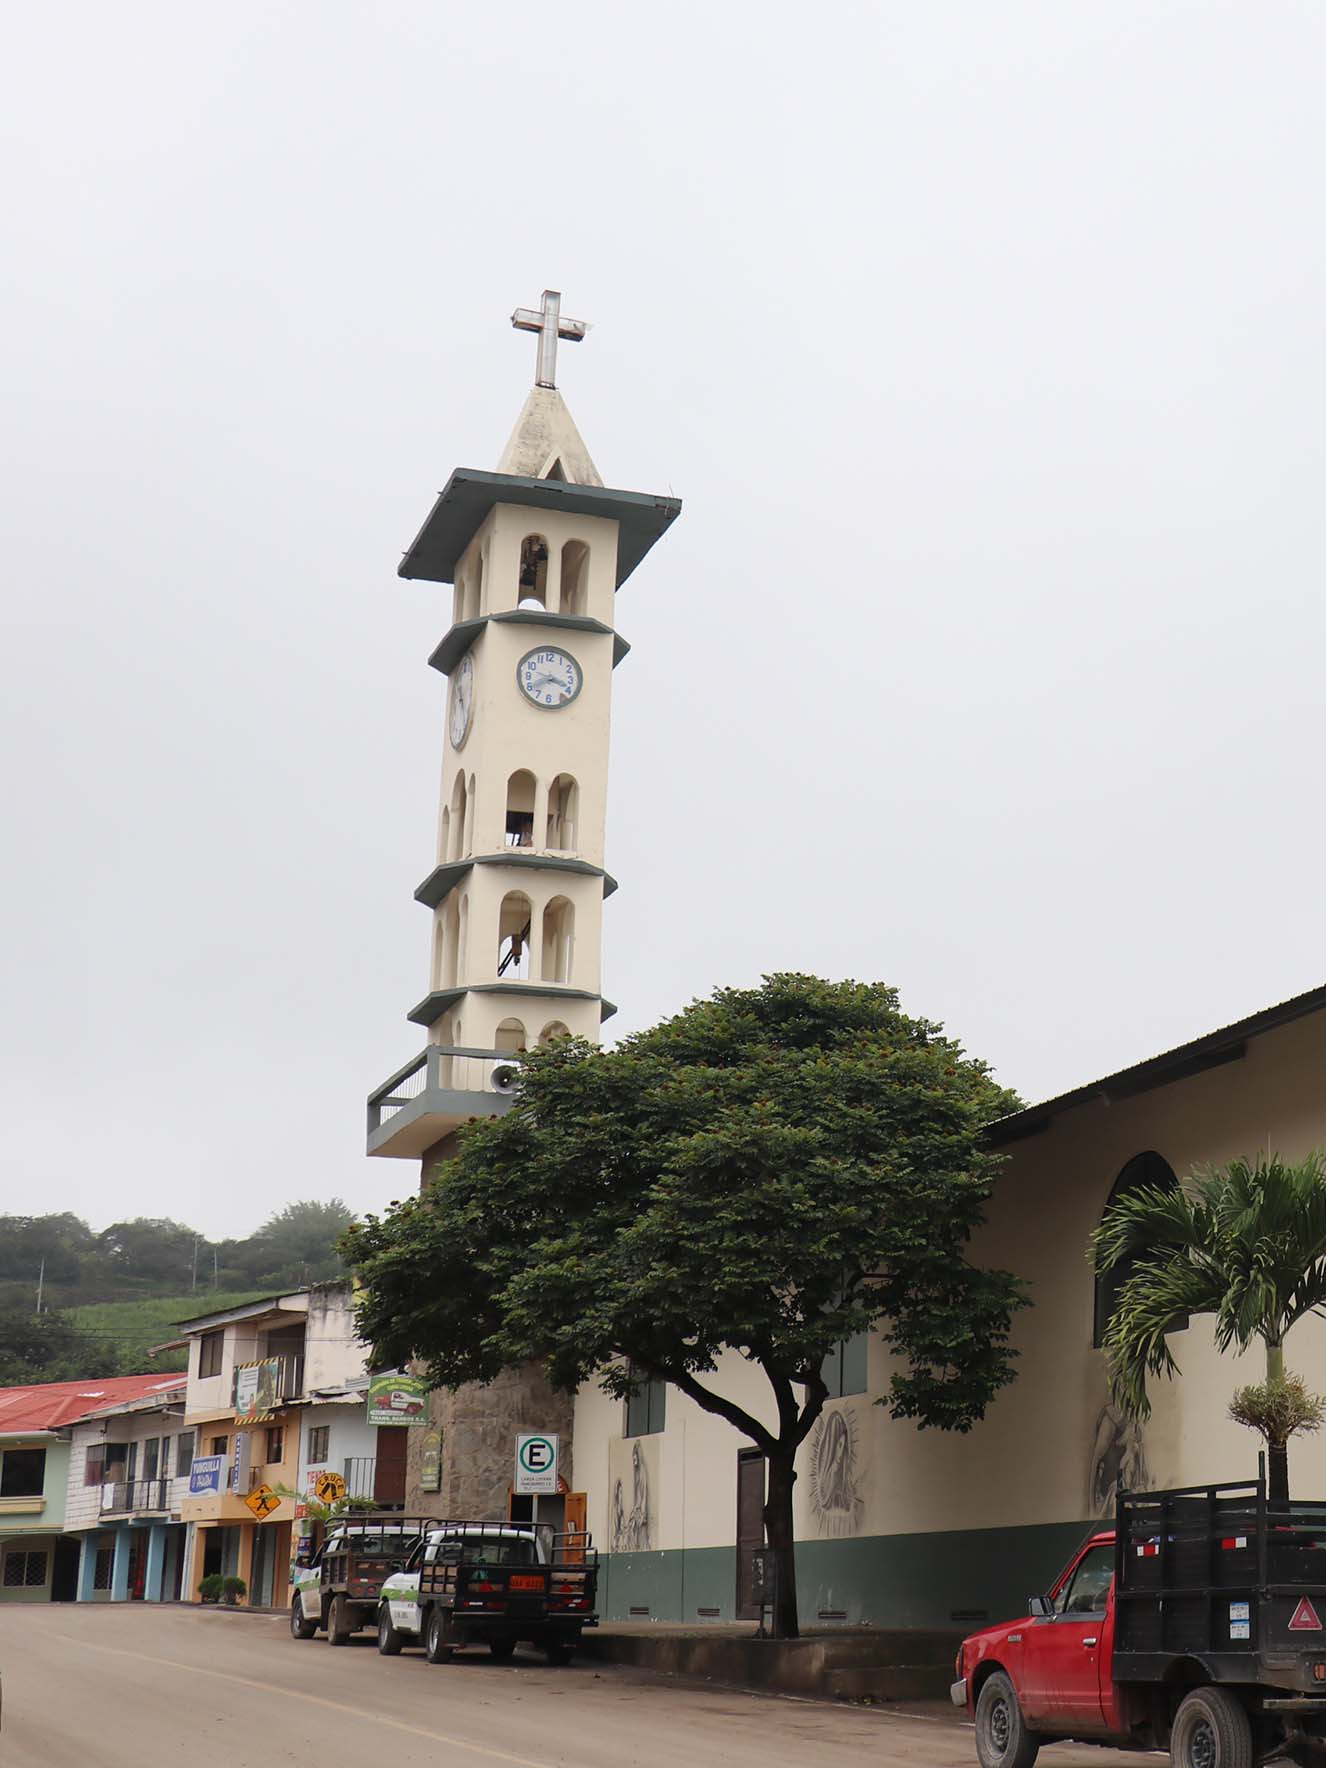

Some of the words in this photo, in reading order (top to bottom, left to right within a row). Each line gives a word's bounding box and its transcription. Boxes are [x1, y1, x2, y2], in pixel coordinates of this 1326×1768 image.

[537, 655, 544, 664] 11
[546, 653, 554, 662] 12
[528, 661, 536, 670] 10
[566, 664, 572, 674] 2
[568, 675, 574, 684] 3
[535, 690, 541, 698] 7
[546, 694, 552, 703] 6
[529, 1444, 546, 1466] E
[193, 1459, 220, 1475] YUNGUILLA
[319, 1474, 345, 1489] CRUCE
